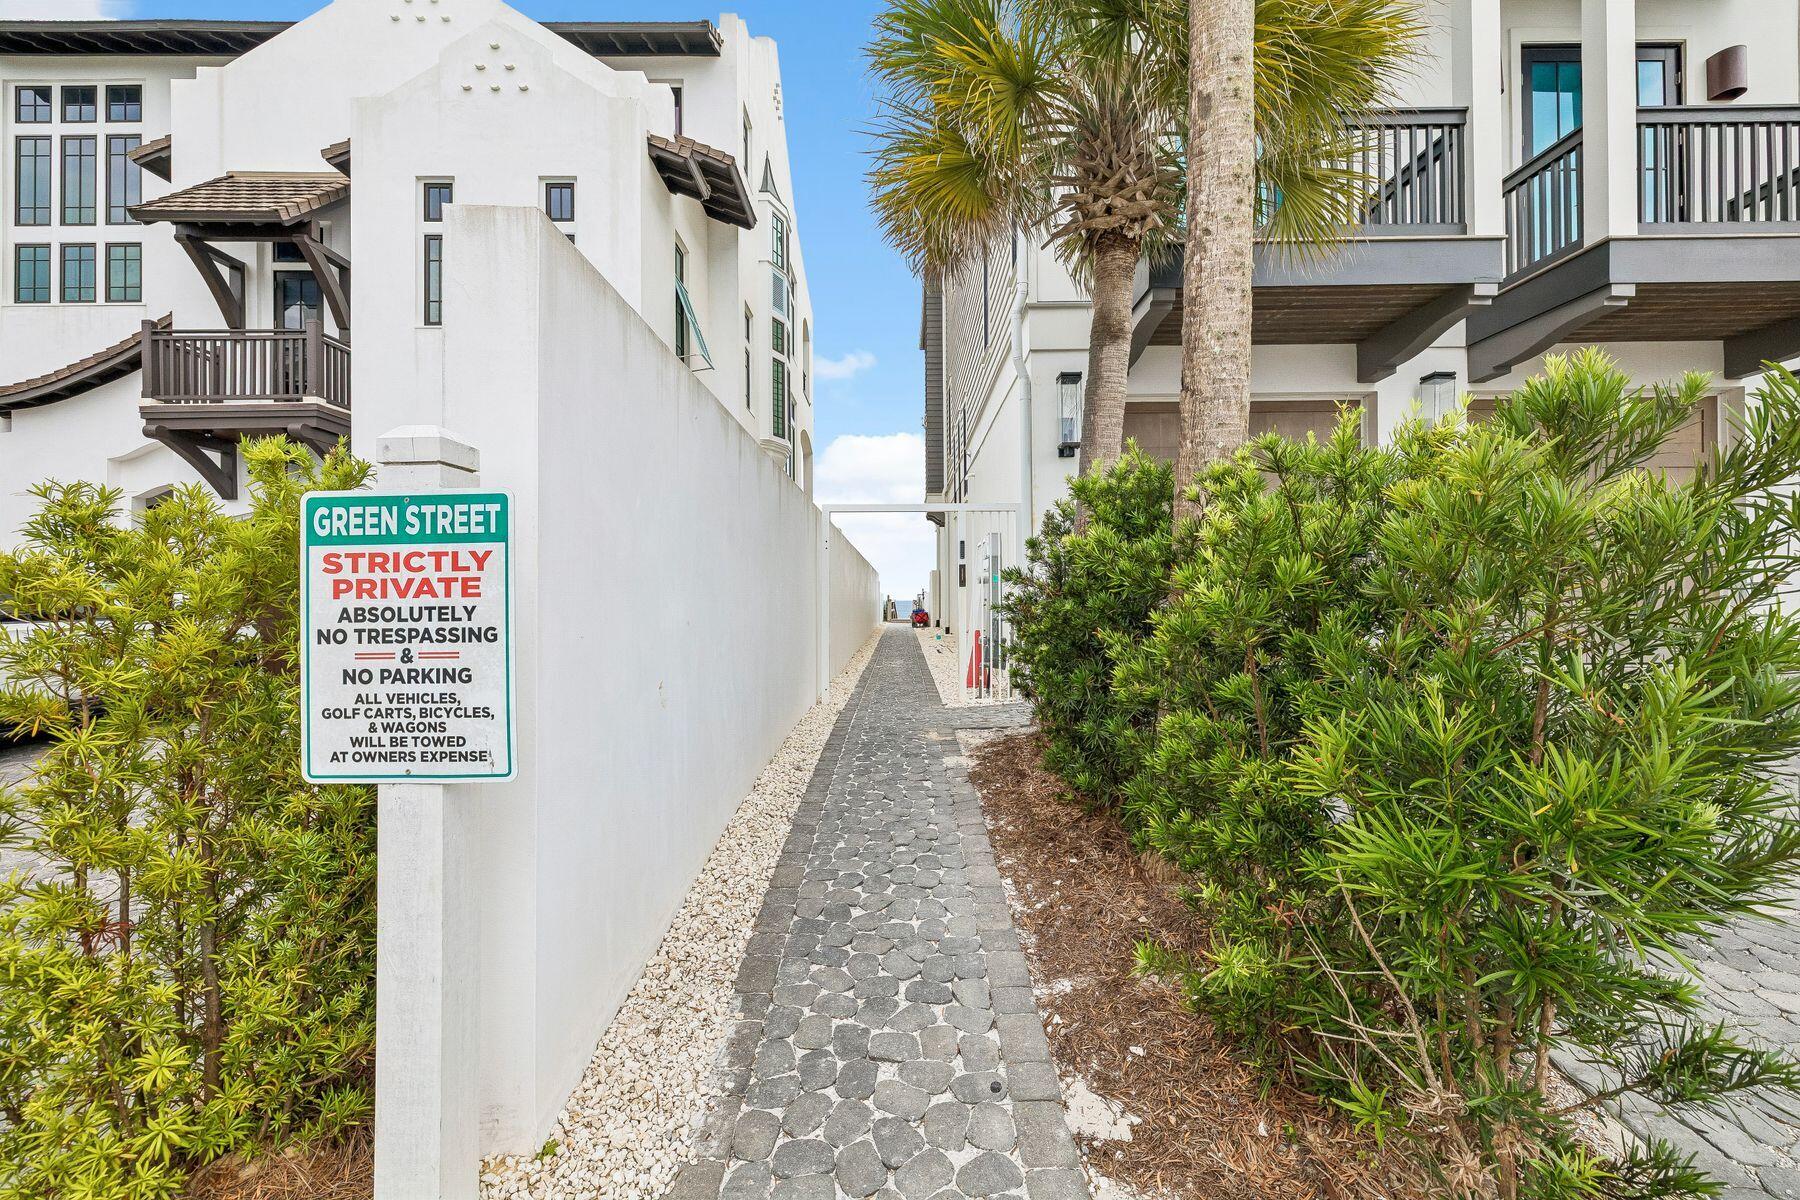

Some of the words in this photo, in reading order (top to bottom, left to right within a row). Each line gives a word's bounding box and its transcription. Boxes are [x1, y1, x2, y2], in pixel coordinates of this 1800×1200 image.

[313, 505, 398, 536] GREEN
[404, 503, 500, 534] STREET
[321, 550, 493, 574] STRICTLY
[332, 577, 482, 600] PRIVATE
[337, 605, 477, 624] ABSOLUTELY
[317, 629, 348, 644] NO
[354, 626, 498, 644] TRESPASSING
[400, 648, 414, 664] &
[342, 669, 373, 684] NO
[380, 668, 472, 684] PARKING
[354, 693, 382, 704] ALL
[386, 693, 461, 706] VEHICLES,
[322, 708, 360, 719] GOLF
[364, 708, 416, 721] CARTS,
[419, 707, 494, 720] BICYCLES,
[368, 722, 378, 733] &
[381, 722, 446, 733] WAGONS
[350, 737, 386, 748] WILL
[390, 737, 407, 748] BE
[412, 737, 466, 748] TOWED
[330, 752, 348, 763] AT
[352, 752, 416, 762] OWNERS
[420, 751, 488, 762] EXPENSE
